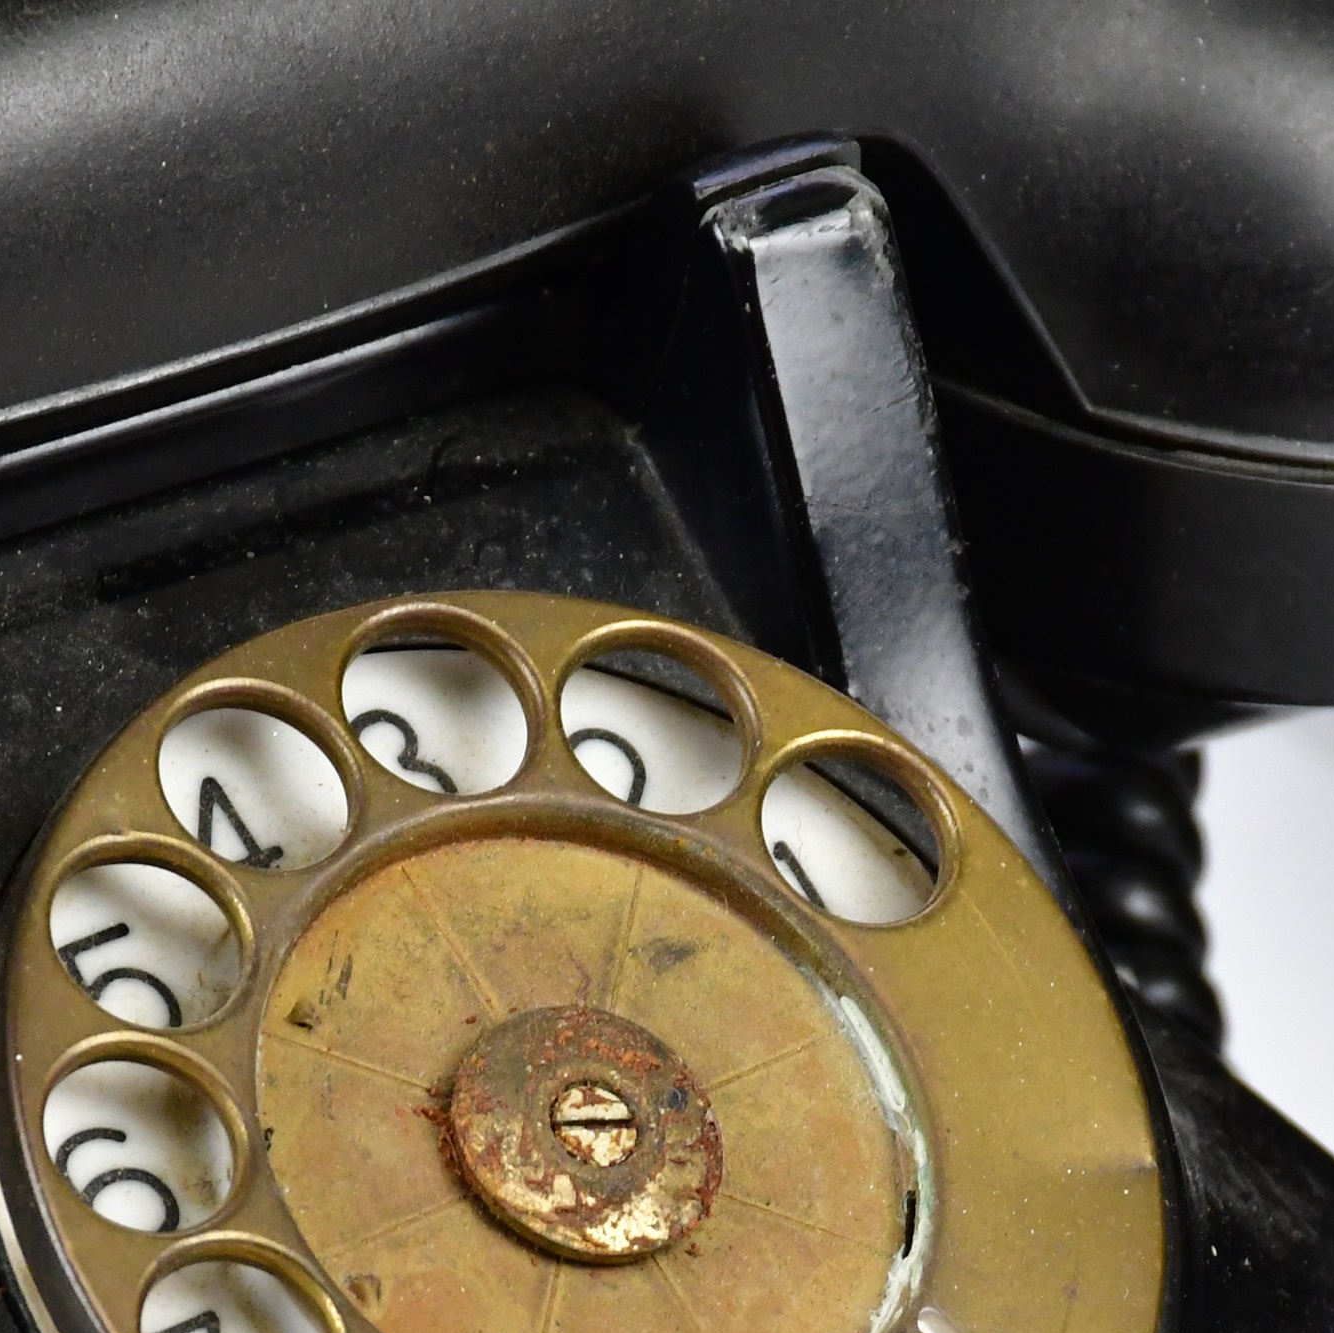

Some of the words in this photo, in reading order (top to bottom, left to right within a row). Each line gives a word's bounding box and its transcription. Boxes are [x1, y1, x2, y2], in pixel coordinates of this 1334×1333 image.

[198, 777, 284, 867] 4
[58, 923, 181, 1027] 5
[55, 1127, 179, 1233] 6
